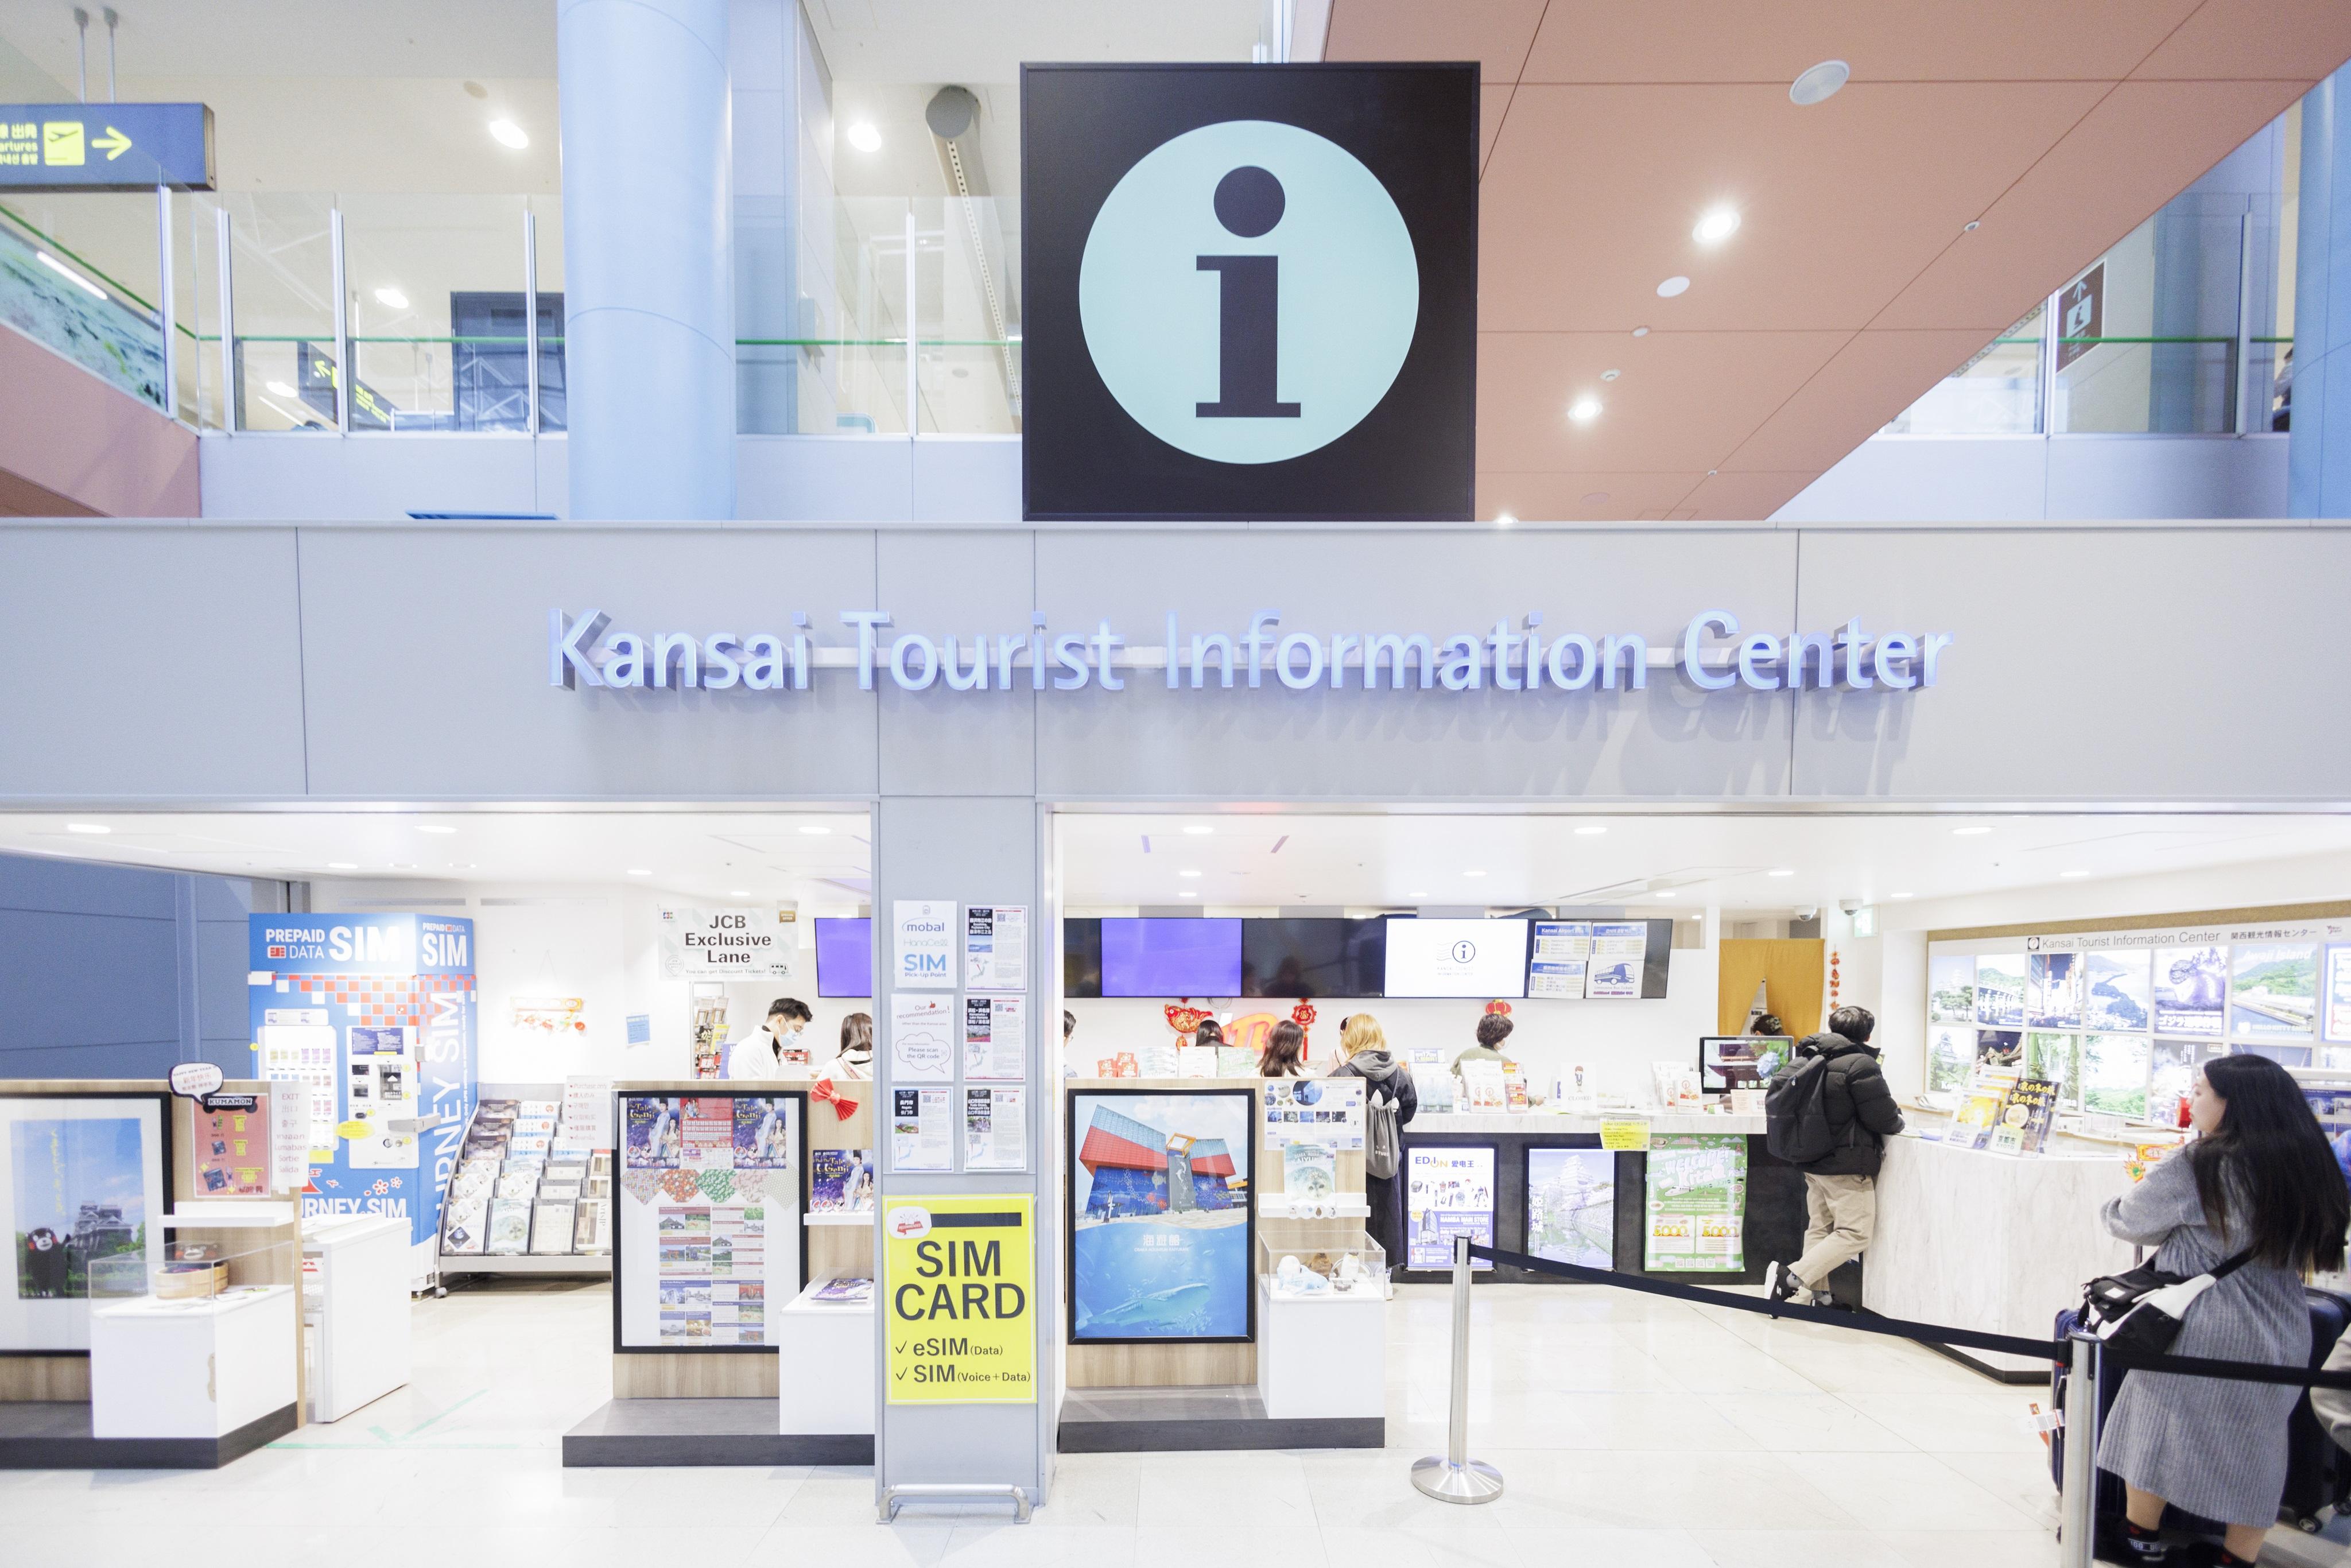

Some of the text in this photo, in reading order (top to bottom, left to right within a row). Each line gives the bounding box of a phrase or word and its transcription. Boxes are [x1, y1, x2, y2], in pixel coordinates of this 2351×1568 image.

[549, 607, 1953, 692] Kansai Tourist Information Center
[422, 922, 446, 932] PREPAID
[709, 915, 747, 929] JCB
[907, 922, 944, 932] mobal
[266, 926, 401, 962] PREPAID SIM
[685, 932, 771, 946] Exclusive
[2042, 936, 2074, 950] Kansai
[2076, 934, 2109, 948] Tourist
[2112, 932, 2175, 946] Information
[2178, 930, 2221, 944] Center
[2230, 928, 2318, 941] 関西観光情報センター
[289, 945, 325, 959] DATA
[421, 933, 468, 967] SIM
[707, 949, 751, 963] Lane
[904, 954, 946, 971] SIM
[430, 991, 460, 1064] SIM
[282, 1093, 300, 1101] EXIT
[1415, 1156, 1448, 1169] EDION
[367, 1198, 407, 1218] SIM
[1143, 1234, 1180, 1246] 海遊館
[915, 1240, 1000, 1278] SIM
[895, 1283, 1025, 1321] CARD
[913, 1337, 1003, 1356] eSIM (Data)
[914, 1364, 955, 1383] SIM
